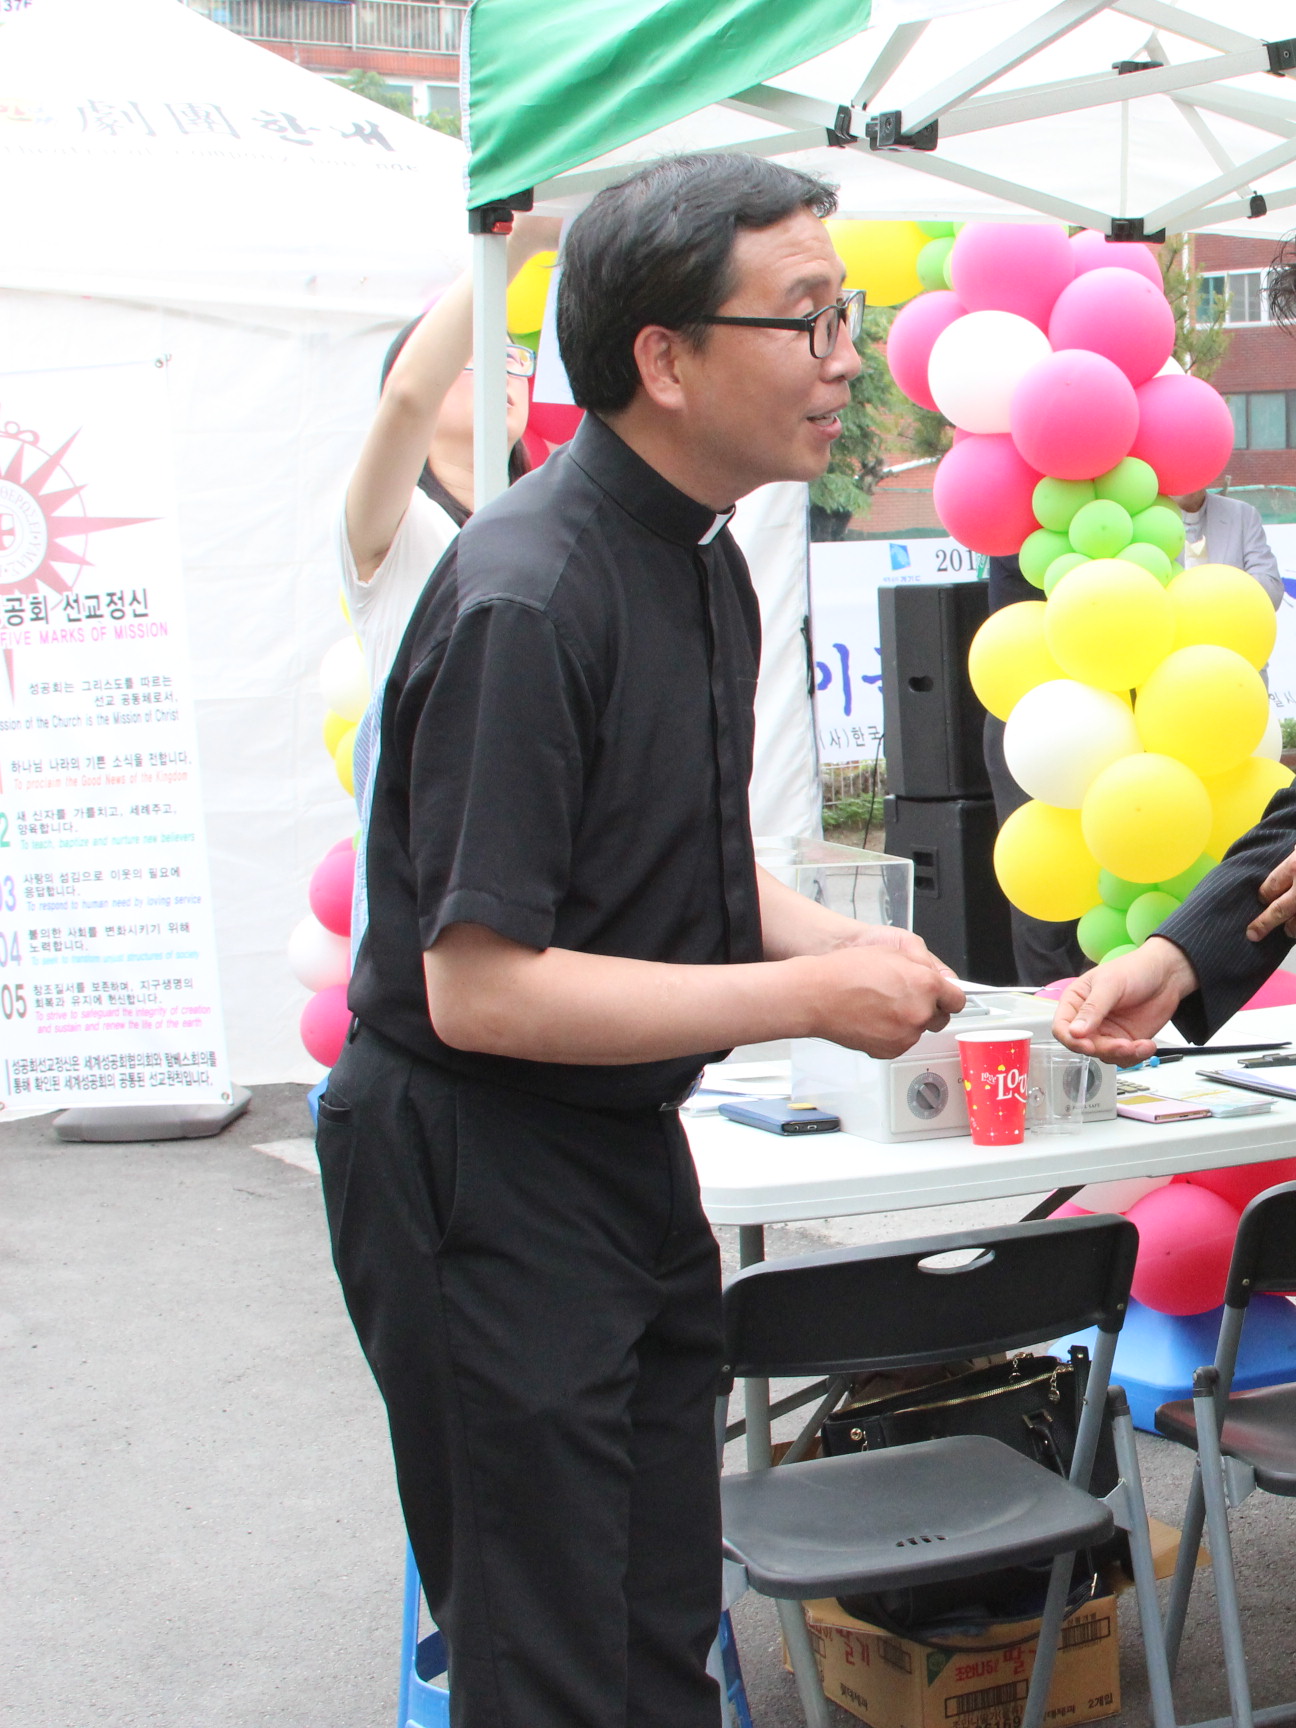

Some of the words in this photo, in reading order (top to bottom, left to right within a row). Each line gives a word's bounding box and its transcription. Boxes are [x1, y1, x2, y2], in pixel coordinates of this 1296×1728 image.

[935, 549, 977, 572] 201
[62, 588, 149, 622] 선교정신
[39, 627, 85, 644] MARKS
[90, 626, 107, 642] OF
[114, 621, 169, 640] MISSION
[29, 681, 75, 695] 성공회는
[82, 677, 134, 691] 그리스도를
[140, 675, 172, 688] 따르는
[94, 695, 115, 708] 선교
[25, 717, 33, 730] of
[36, 716, 49, 729] the
[52, 714, 82, 728] Church
[86, 715, 93, 727] is
[96, 713, 110, 726] the
[113, 711, 142, 725] Mission
[145, 710, 153, 723] of
[155, 708, 180, 722] Christ
[11, 758, 43, 774] 하나님
[49, 756, 80, 772] 나라의
[112, 753, 143, 768] 소식을
[14, 778, 23, 791] To
[26, 777, 62, 791] proclaim
[65, 775, 78, 788] the
[81, 774, 102, 787] Good
[105, 773, 126, 786] News
[129, 772, 138, 784] of
[141, 771, 153, 783] the
[156, 770, 188, 784] Kingdom
[16, 810, 27, 822] 새
[161, 832, 195, 844] believers
[24, 873, 54, 885] 사랑의
[59, 870, 104, 884] 섬김으로
[110, 868, 143, 880] 이웃의
[148, 866, 181, 879] 필요에
[27, 901, 36, 911] To
[39, 900, 68, 912] respond
[82, 899, 109, 909] human
[111, 898, 131, 908] need
[134, 897, 143, 909] by
[147, 896, 171, 908] loving
[174, 895, 202, 905] service
[1, 984, 27, 1020] 05
[35, 1011, 44, 1022] To
[46, 1010, 67, 1021] strive
[81, 1007, 120, 1021] safeguard
[122, 1007, 133, 1018] the
[135, 1006, 167, 1020] integrity
[170, 1006, 178, 1016] of
[181, 1004, 211, 1016] creation
[37, 1023, 52, 1034] and
[54, 1022, 82, 1034] sustain
[84, 1021, 99, 1032] and
[103, 1020, 126, 1031] renew
[128, 1019, 140, 1030] the
[155, 1018, 164, 1029] of
[167, 1018, 179, 1028] the
[182, 1017, 202, 1028] earth
[12, 1055, 80, 1076] 성공회선교정신은
[13, 1076, 31, 1095] 통해
[64, 1072, 115, 1091] 세계성공회의
[118, 1071, 145, 1089] 공통된
[1087, 1693, 1114, 1709] 2개입
